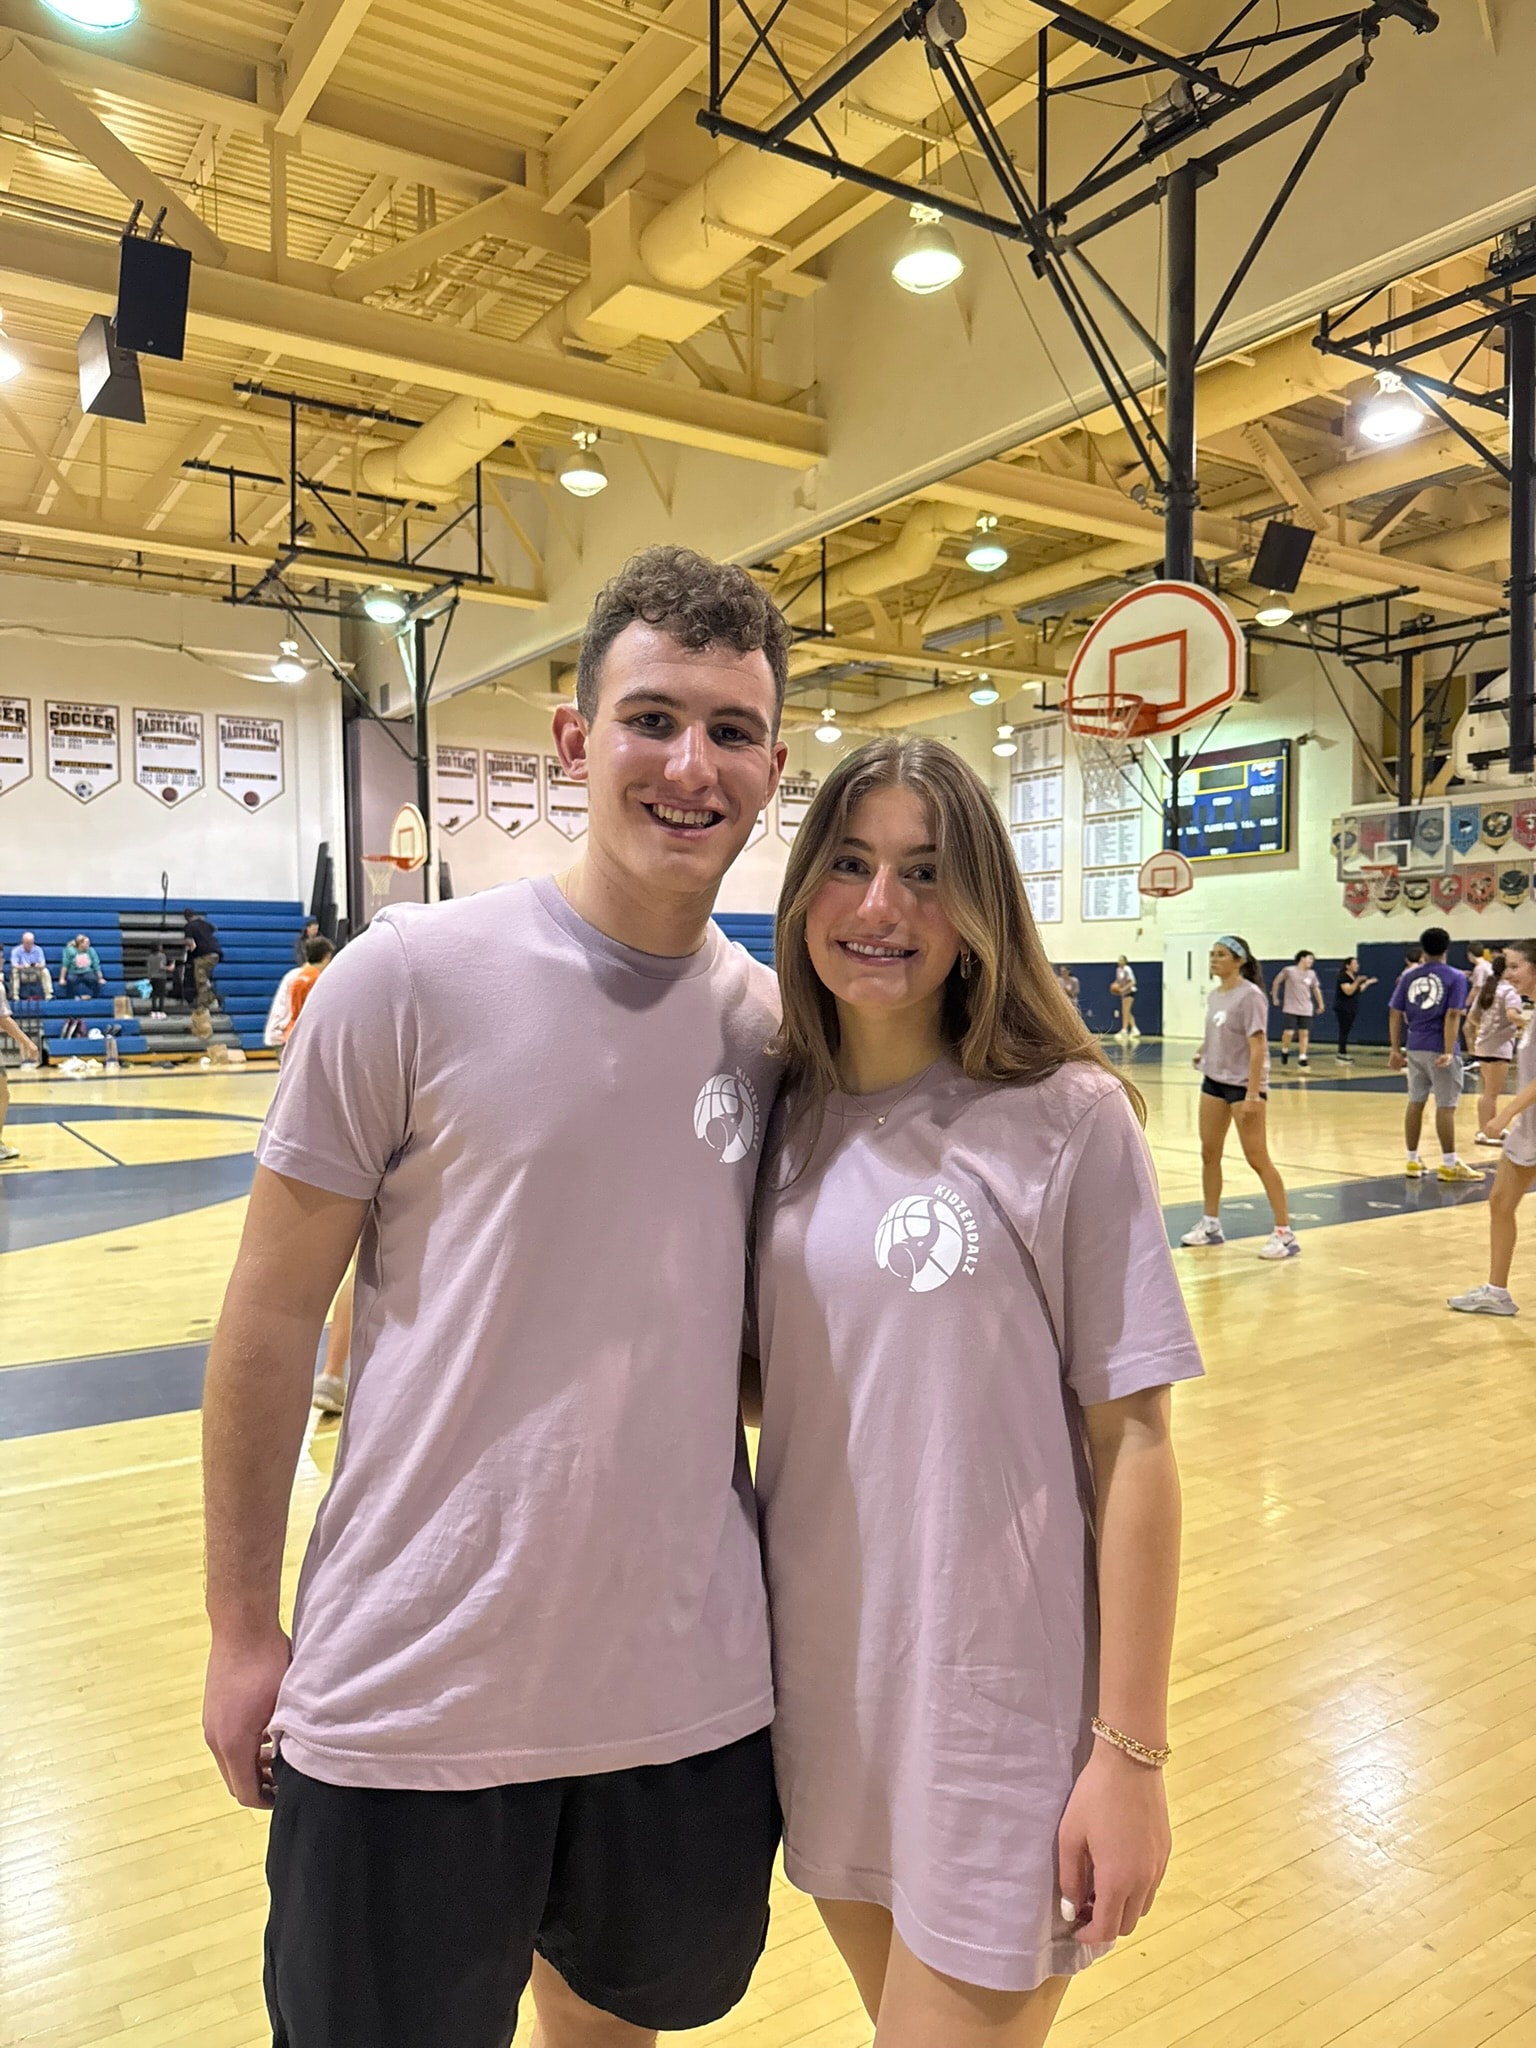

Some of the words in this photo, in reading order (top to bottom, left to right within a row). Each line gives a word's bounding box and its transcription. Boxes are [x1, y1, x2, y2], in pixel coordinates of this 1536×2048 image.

[50, 711, 115, 733] SOCCER
[137, 718, 200, 739] BASKETBALL
[221, 725, 280, 746] BASKETBALL
[933, 1184, 979, 1276] KIDZENDALZ
